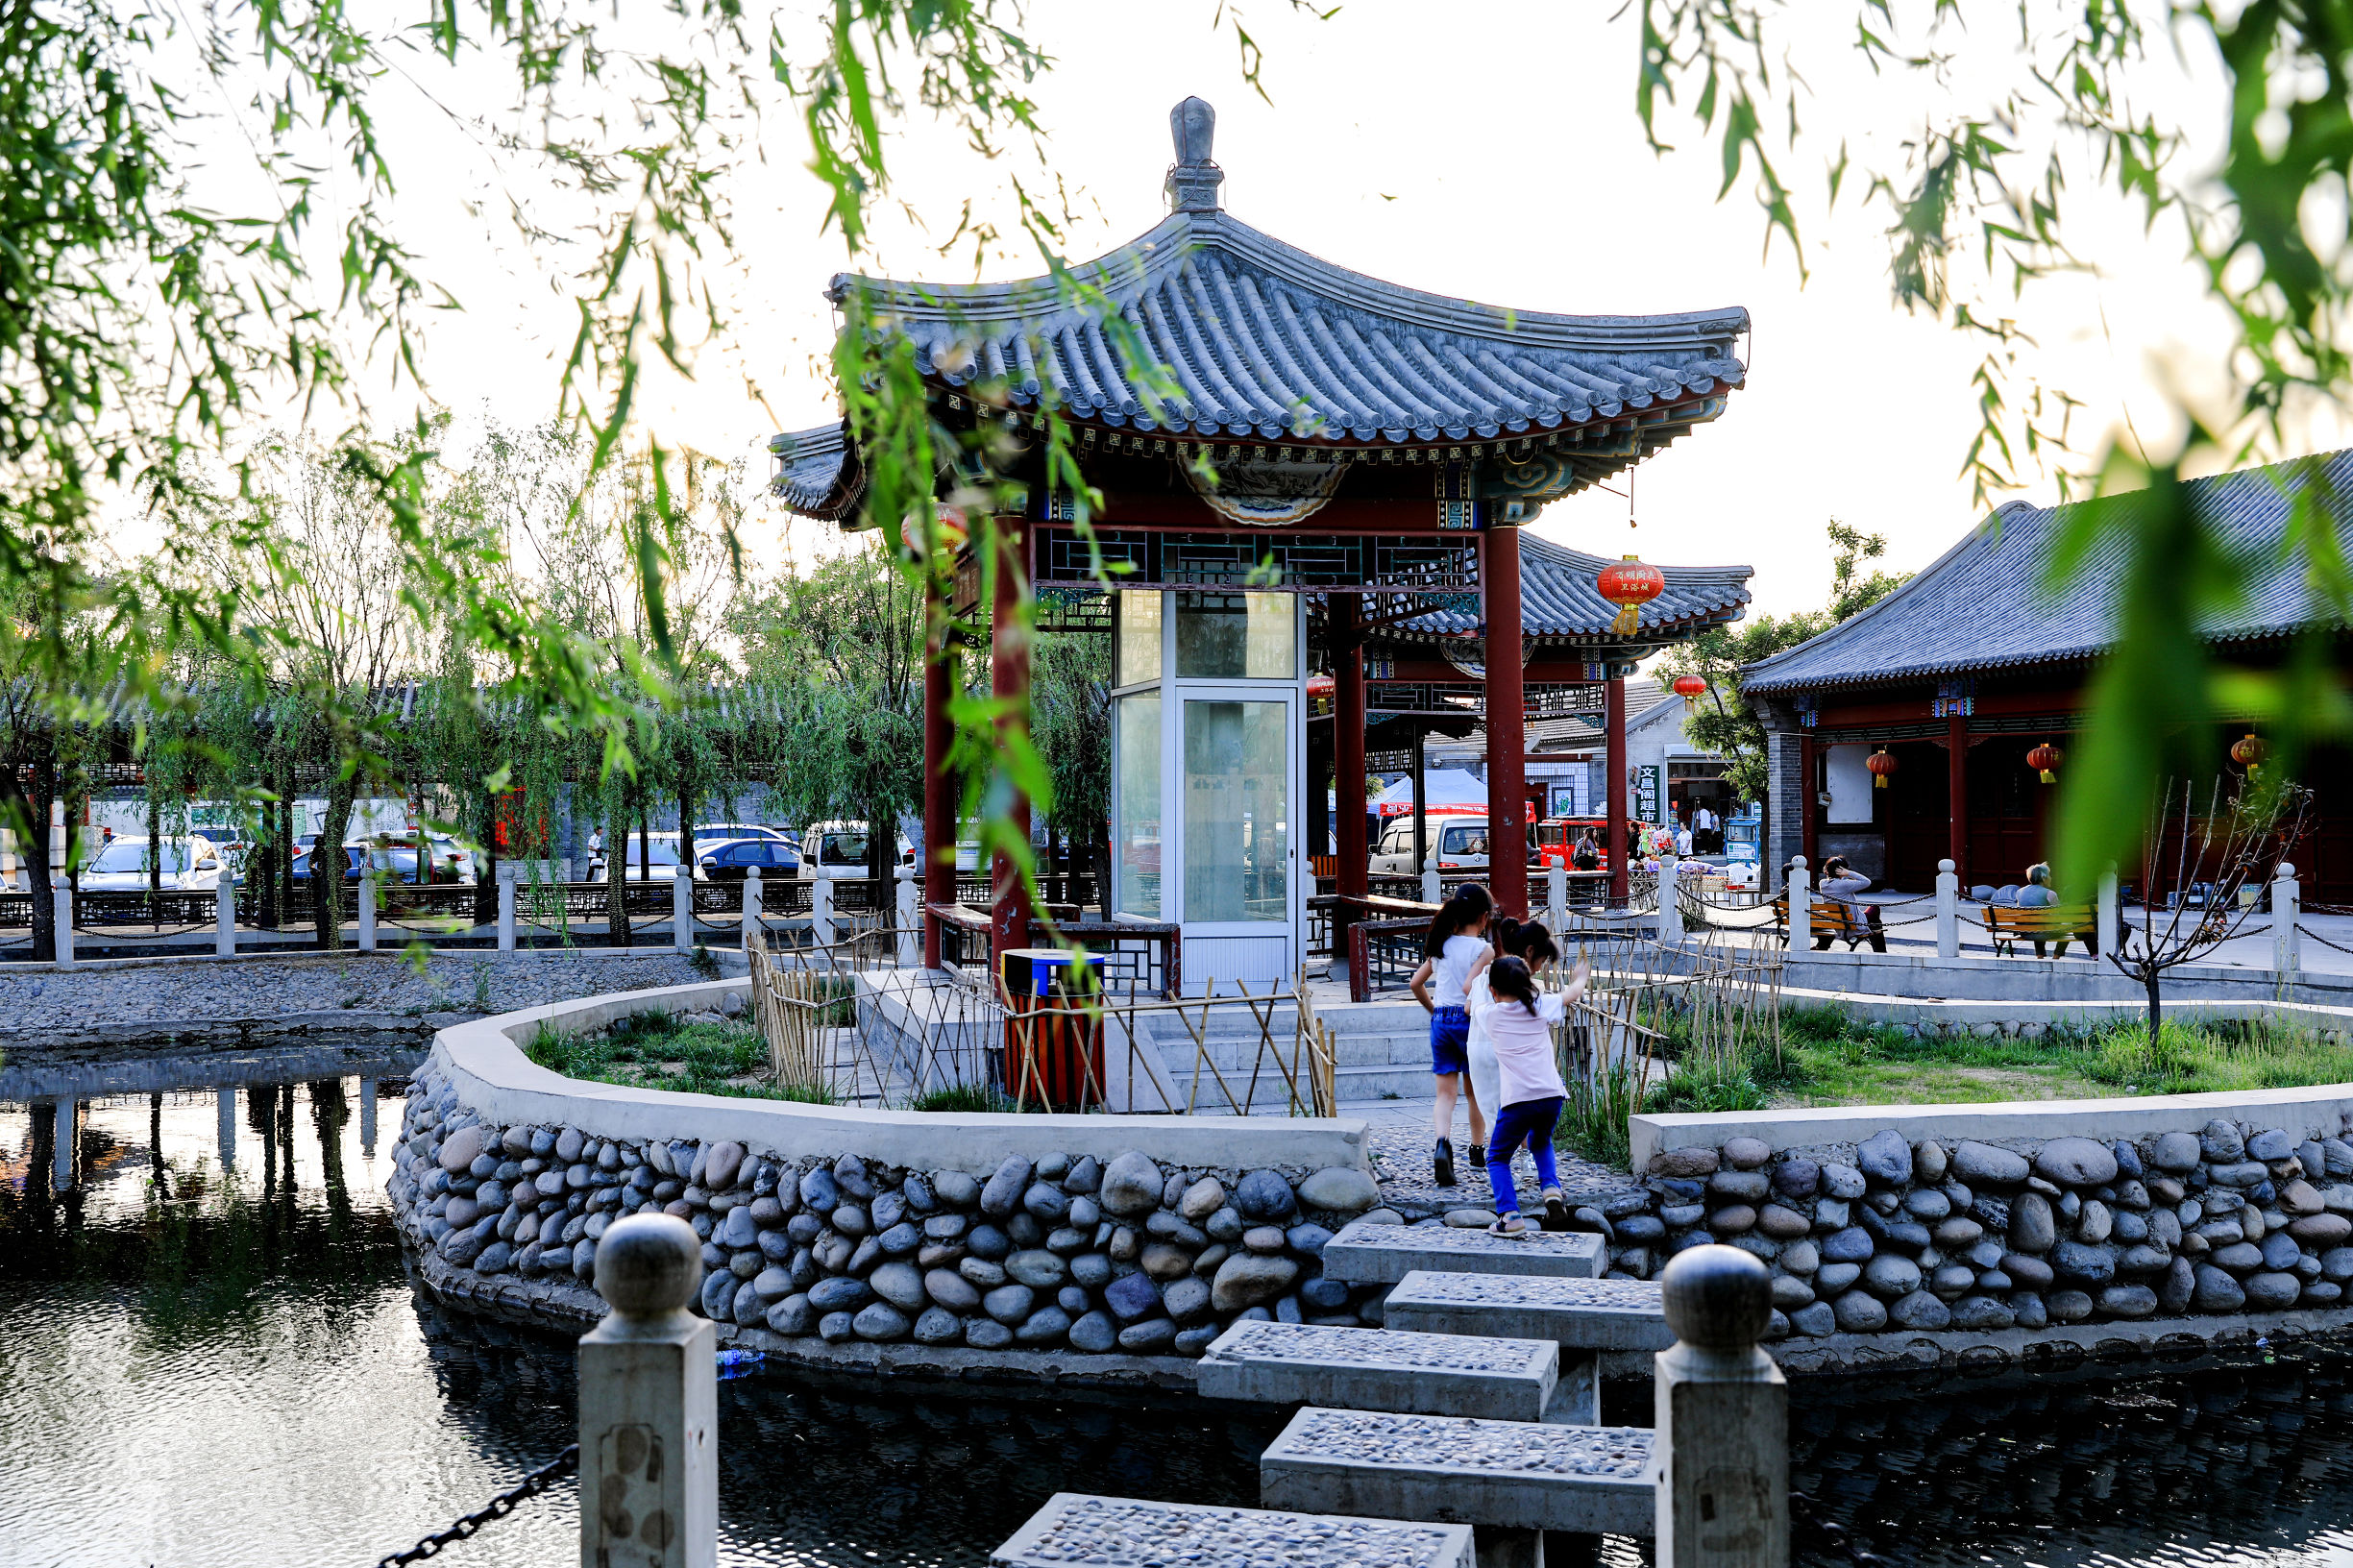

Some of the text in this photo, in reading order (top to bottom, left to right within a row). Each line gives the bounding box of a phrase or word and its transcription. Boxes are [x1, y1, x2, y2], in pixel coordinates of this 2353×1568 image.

[1640, 767, 1656, 822] 文昌阁超市
